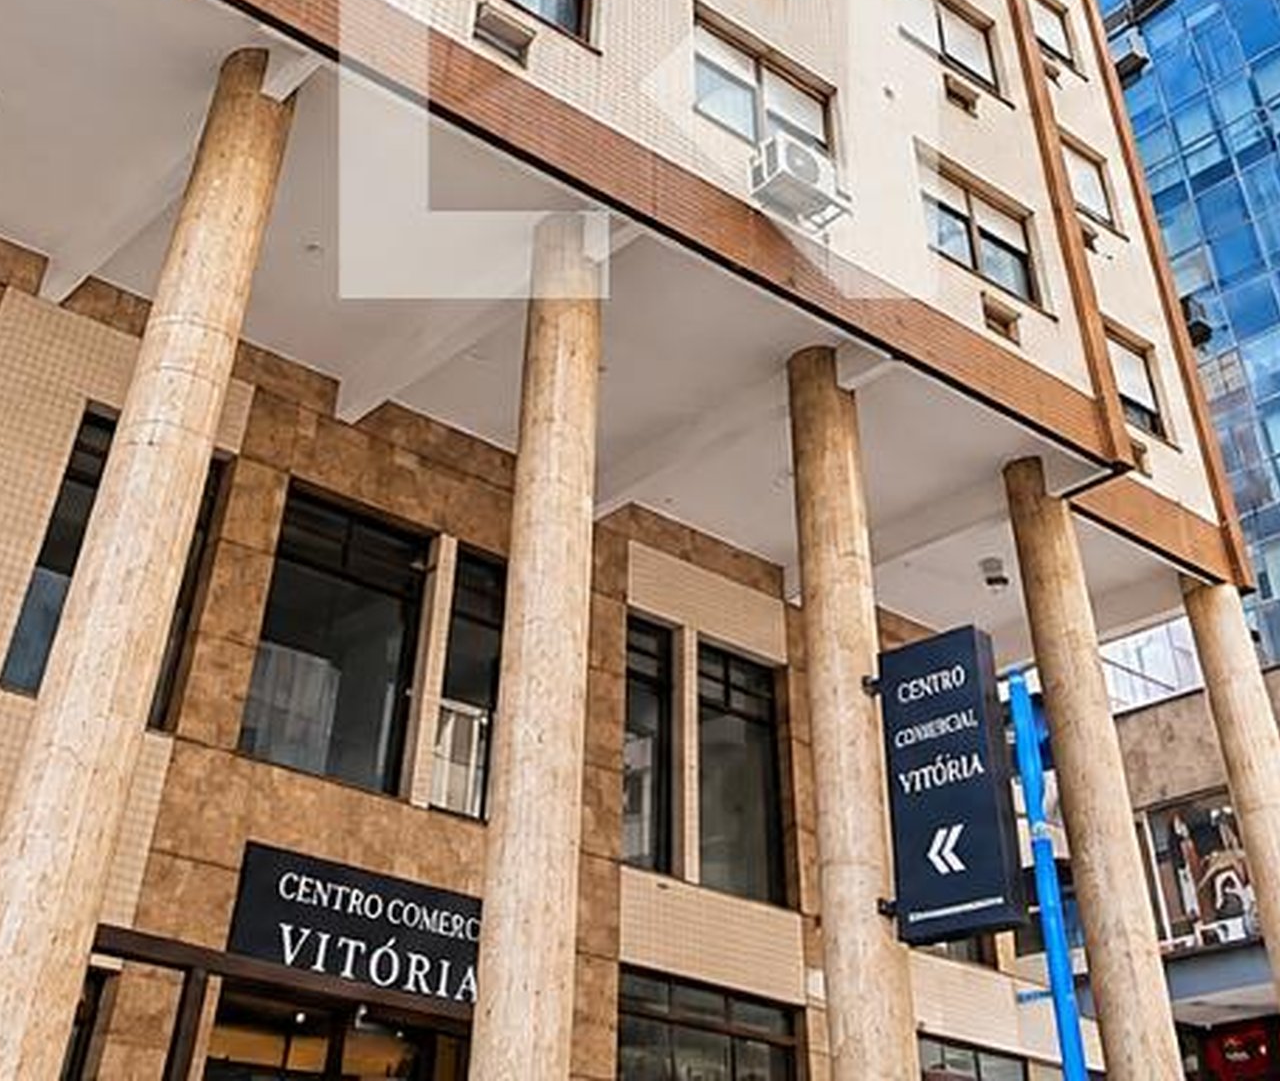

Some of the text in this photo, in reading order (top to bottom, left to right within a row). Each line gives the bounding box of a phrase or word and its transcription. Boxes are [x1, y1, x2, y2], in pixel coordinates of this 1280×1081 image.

[898, 665, 965, 703] CENTRO
[898, 752, 985, 794] VITÓRIA
[278, 872, 479, 942] CENTRO COMERC
[278, 922, 478, 1003] VITÓRIA
